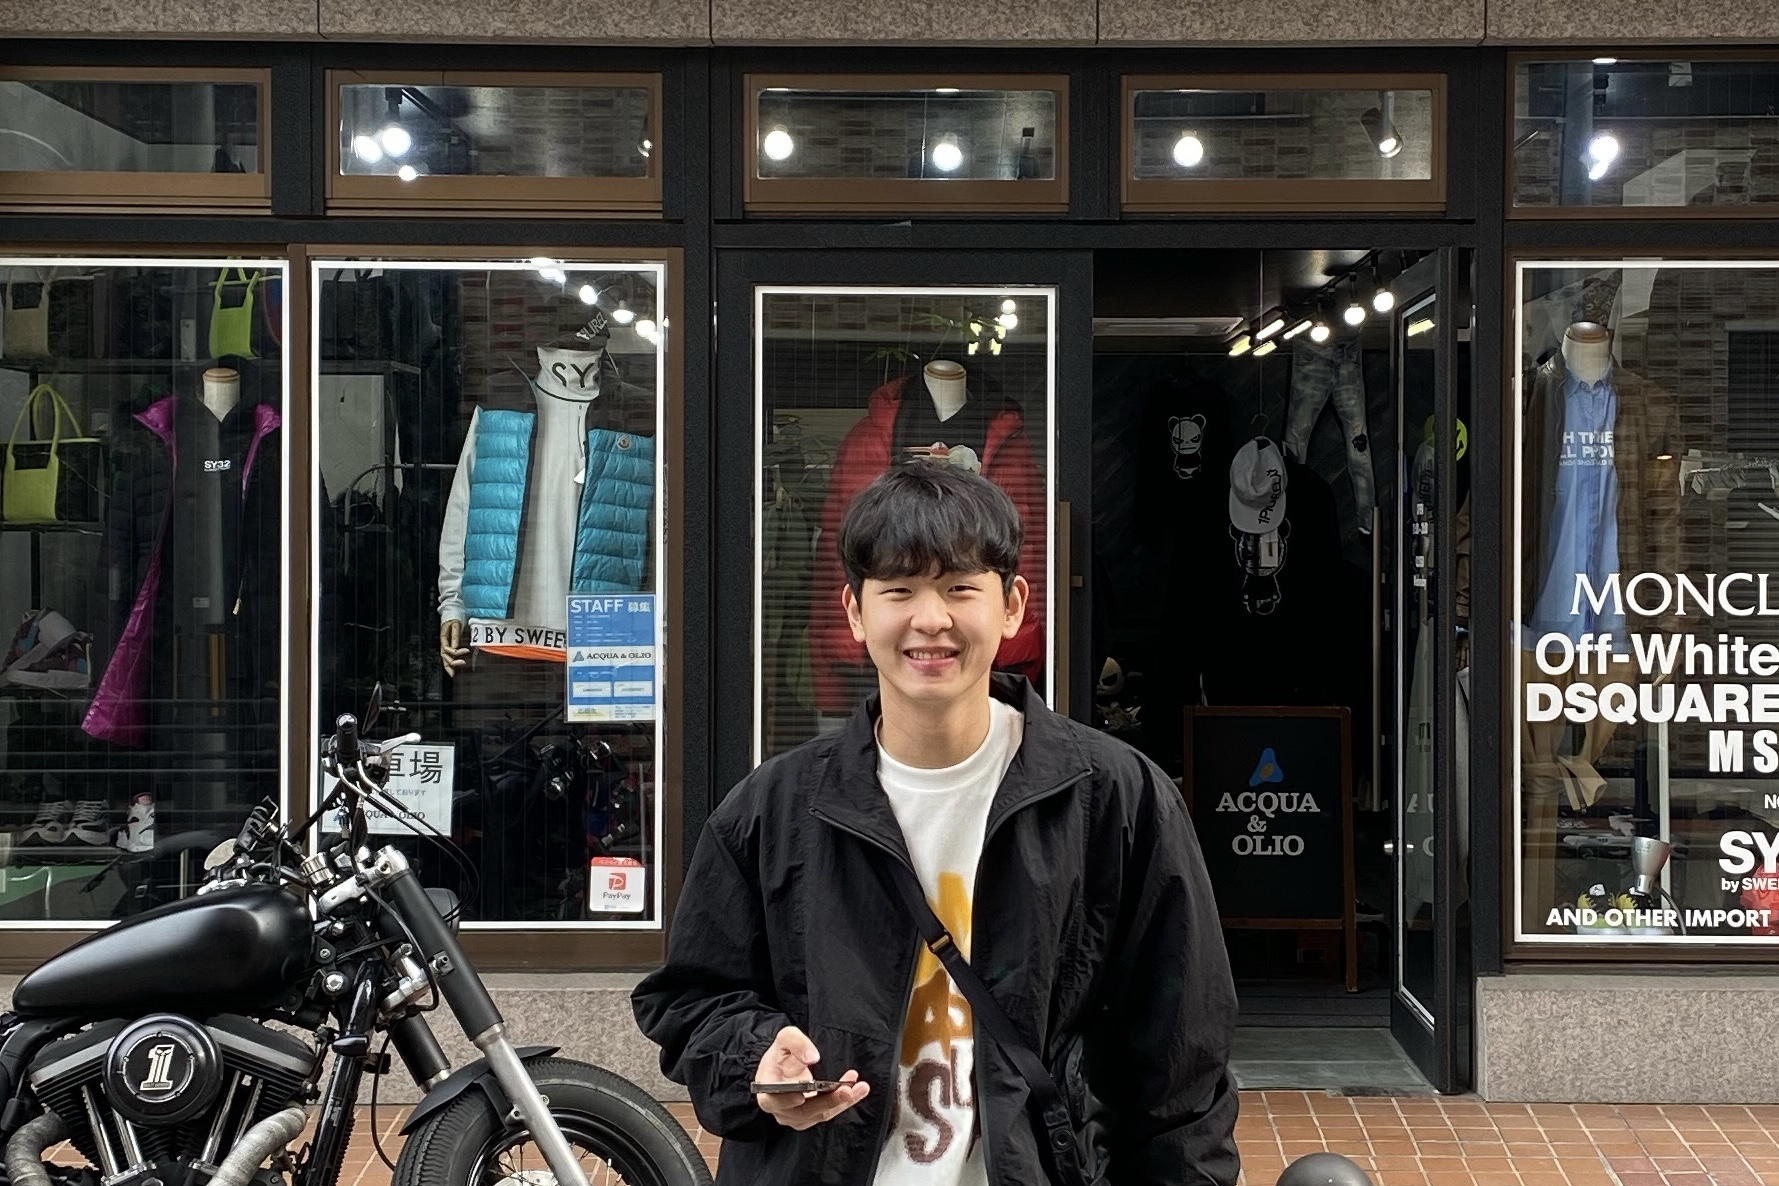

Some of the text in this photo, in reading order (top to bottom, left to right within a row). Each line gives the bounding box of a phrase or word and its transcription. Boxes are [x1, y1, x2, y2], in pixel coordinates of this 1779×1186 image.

[204, 459, 231, 468] SY32
[1570, 572, 1779, 616] MONCL
[571, 599, 624, 613] STAFF
[485, 627, 508, 643] BY
[587, 652, 619, 660] ACQUA
[1535, 632, 1779, 677] Off-White
[1526, 682, 1779, 726] DSQUARE
[1215, 791, 1321, 818] ACQUA
[1246, 814, 1267, 833] &
[1231, 834, 1305, 856] OLIO
[1718, 830, 1779, 875] SY
[1721, 877, 1779, 893] by SWE
[602, 891, 631, 900] PayPay
[1546, 908, 1772, 928] AND OTHER IMPORT
[139, 1044, 175, 1091] 1
